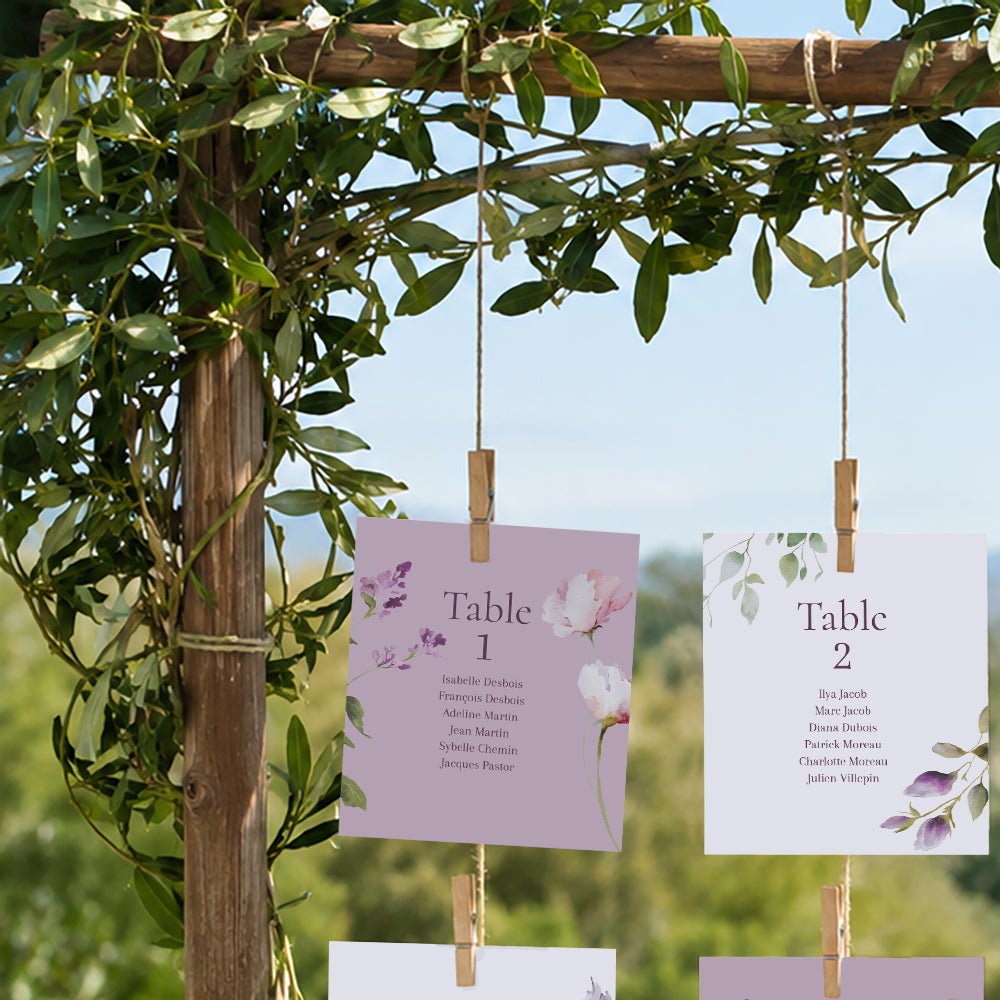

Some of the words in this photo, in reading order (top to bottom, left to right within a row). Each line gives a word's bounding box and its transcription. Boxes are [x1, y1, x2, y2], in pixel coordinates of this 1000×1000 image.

[443, 590, 531, 625] Table
[797, 598, 887, 631] Table
[476, 634, 492, 661] 1
[833, 642, 852, 670] 2
[442, 674, 481, 687] Isabelle
[484, 677, 523, 689] Desbois
[439, 690, 483, 704] François
[485, 693, 525, 705] Desbois
[819, 689, 837, 701] Ilya
[838, 689, 867, 701] Jacob
[442, 708, 481, 720] Adeline
[484, 710, 518, 722] Martin
[815, 705, 841, 716] Marc
[842, 705, 871, 718] Jacob
[448, 724, 472, 736] Jean
[475, 726, 509, 738] Martin
[809, 723, 839, 732] Diana
[842, 722, 878, 732] Dubois
[439, 740, 475, 754] Sybelle
[478, 743, 518, 756] Chemin
[804, 739, 840, 749] Patrick
[843, 739, 881, 749] Moreau
[439, 757, 479, 771] Jacques
[482, 760, 515, 772] Pastor
[799, 756, 846, 766] Charlotte
[849, 756, 888, 766] Moreau
[806, 773, 837, 785] Julien
[840, 773, 879, 786] Villepin
